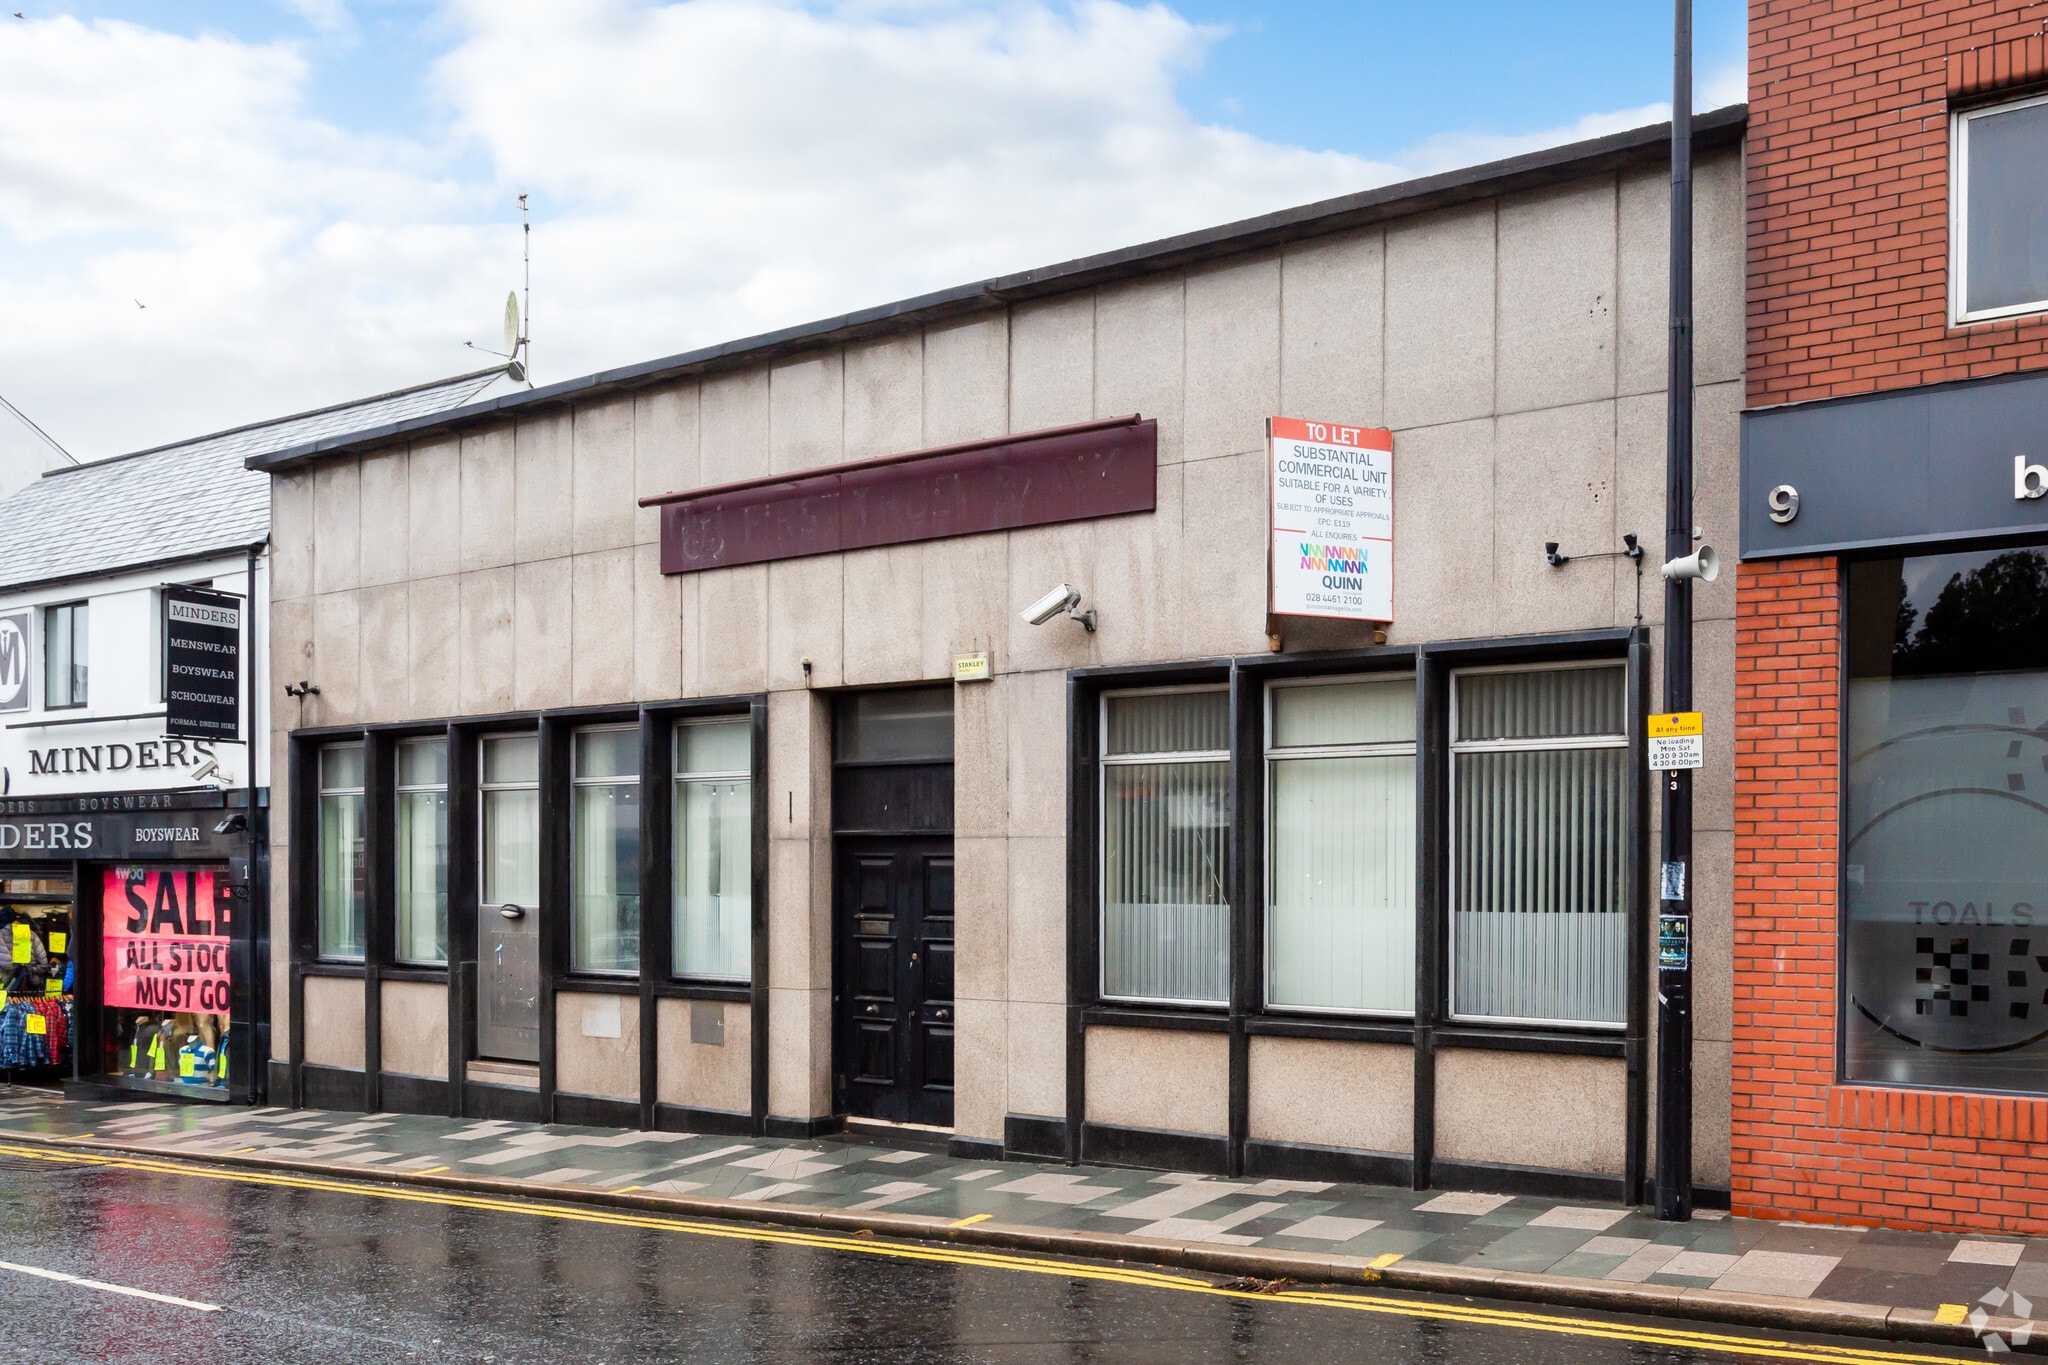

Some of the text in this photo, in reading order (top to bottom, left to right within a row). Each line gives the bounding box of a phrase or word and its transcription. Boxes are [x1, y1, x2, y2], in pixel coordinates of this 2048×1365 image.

[1306, 422, 1360, 445] TO LET
[1294, 445, 1373, 466] SUBSTANTIAL
[1278, 460, 1387, 484] COMMERCIAL UNIT
[1279, 478, 1387, 498] SUITABLE FOR A VARIETY
[1315, 494, 1353, 506] OF USES
[1768, 484, 1799, 523] 9
[1276, 503, 1302, 512] SUBJECT
[1313, 506, 1354, 517] APPROPRIATE
[1356, 511, 1390, 520] APPROVALS
[1334, 519, 1350, 528] E119
[1311, 530, 1357, 541] ALL ENQUIRIES
[1322, 575, 1362, 590] QUINN
[1306, 593, 1362, 605] 028 4461 2100
[172, 605, 236, 624] MINDERS
[171, 638, 236, 654] MENSWEAR
[172, 664, 235, 680] BOYSWEAR
[171, 691, 235, 705] SCHOOLWEAR
[170, 718, 198, 726] FORMAL
[200, 720, 219, 728] DRESS
[80, 795, 172, 810] BOYSWEAR
[0, 822, 93, 849] DERS
[135, 827, 200, 842] BOYSWEAR
[125, 872, 230, 936] SALE
[1908, 901, 2034, 927] TOALS
[126, 941, 163, 970] ALL
[136, 976, 230, 1011] MUST GO
